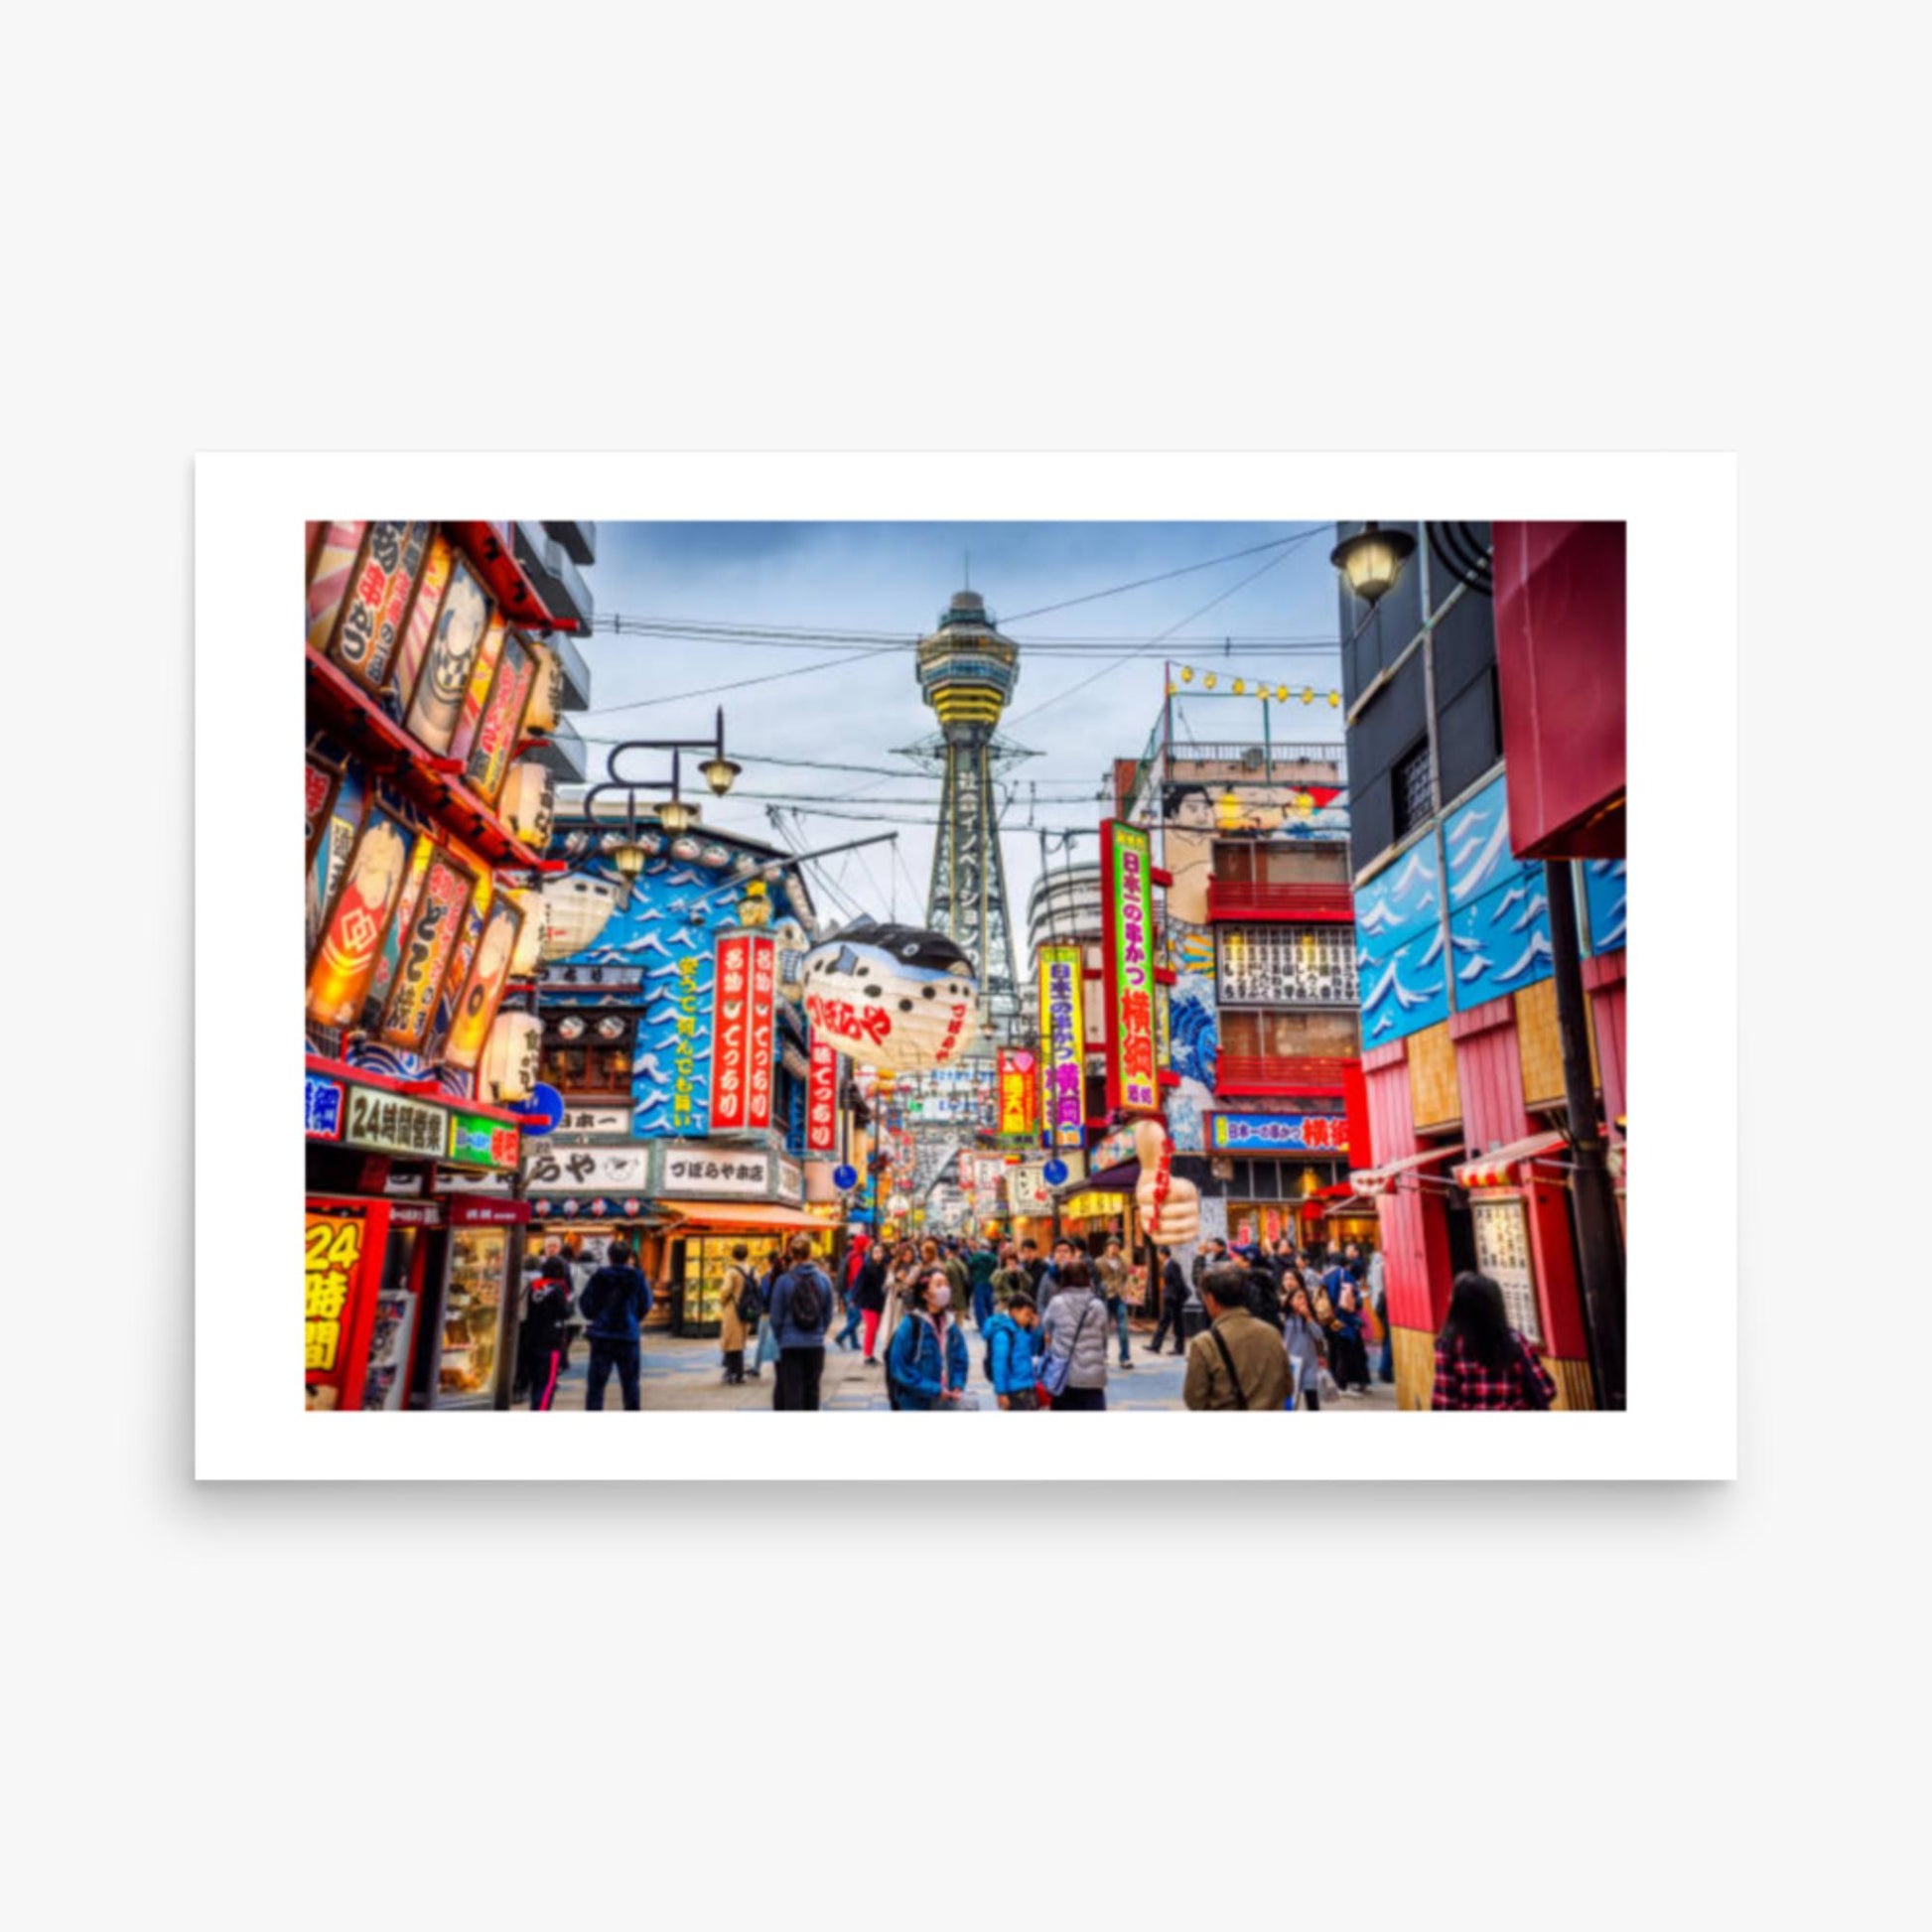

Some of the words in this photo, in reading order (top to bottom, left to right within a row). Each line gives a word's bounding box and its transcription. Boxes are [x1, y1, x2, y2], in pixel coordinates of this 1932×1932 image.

[352, 1096, 442, 1151] 24時間営業
[670, 1162, 763, 1181] づぼらや本店
